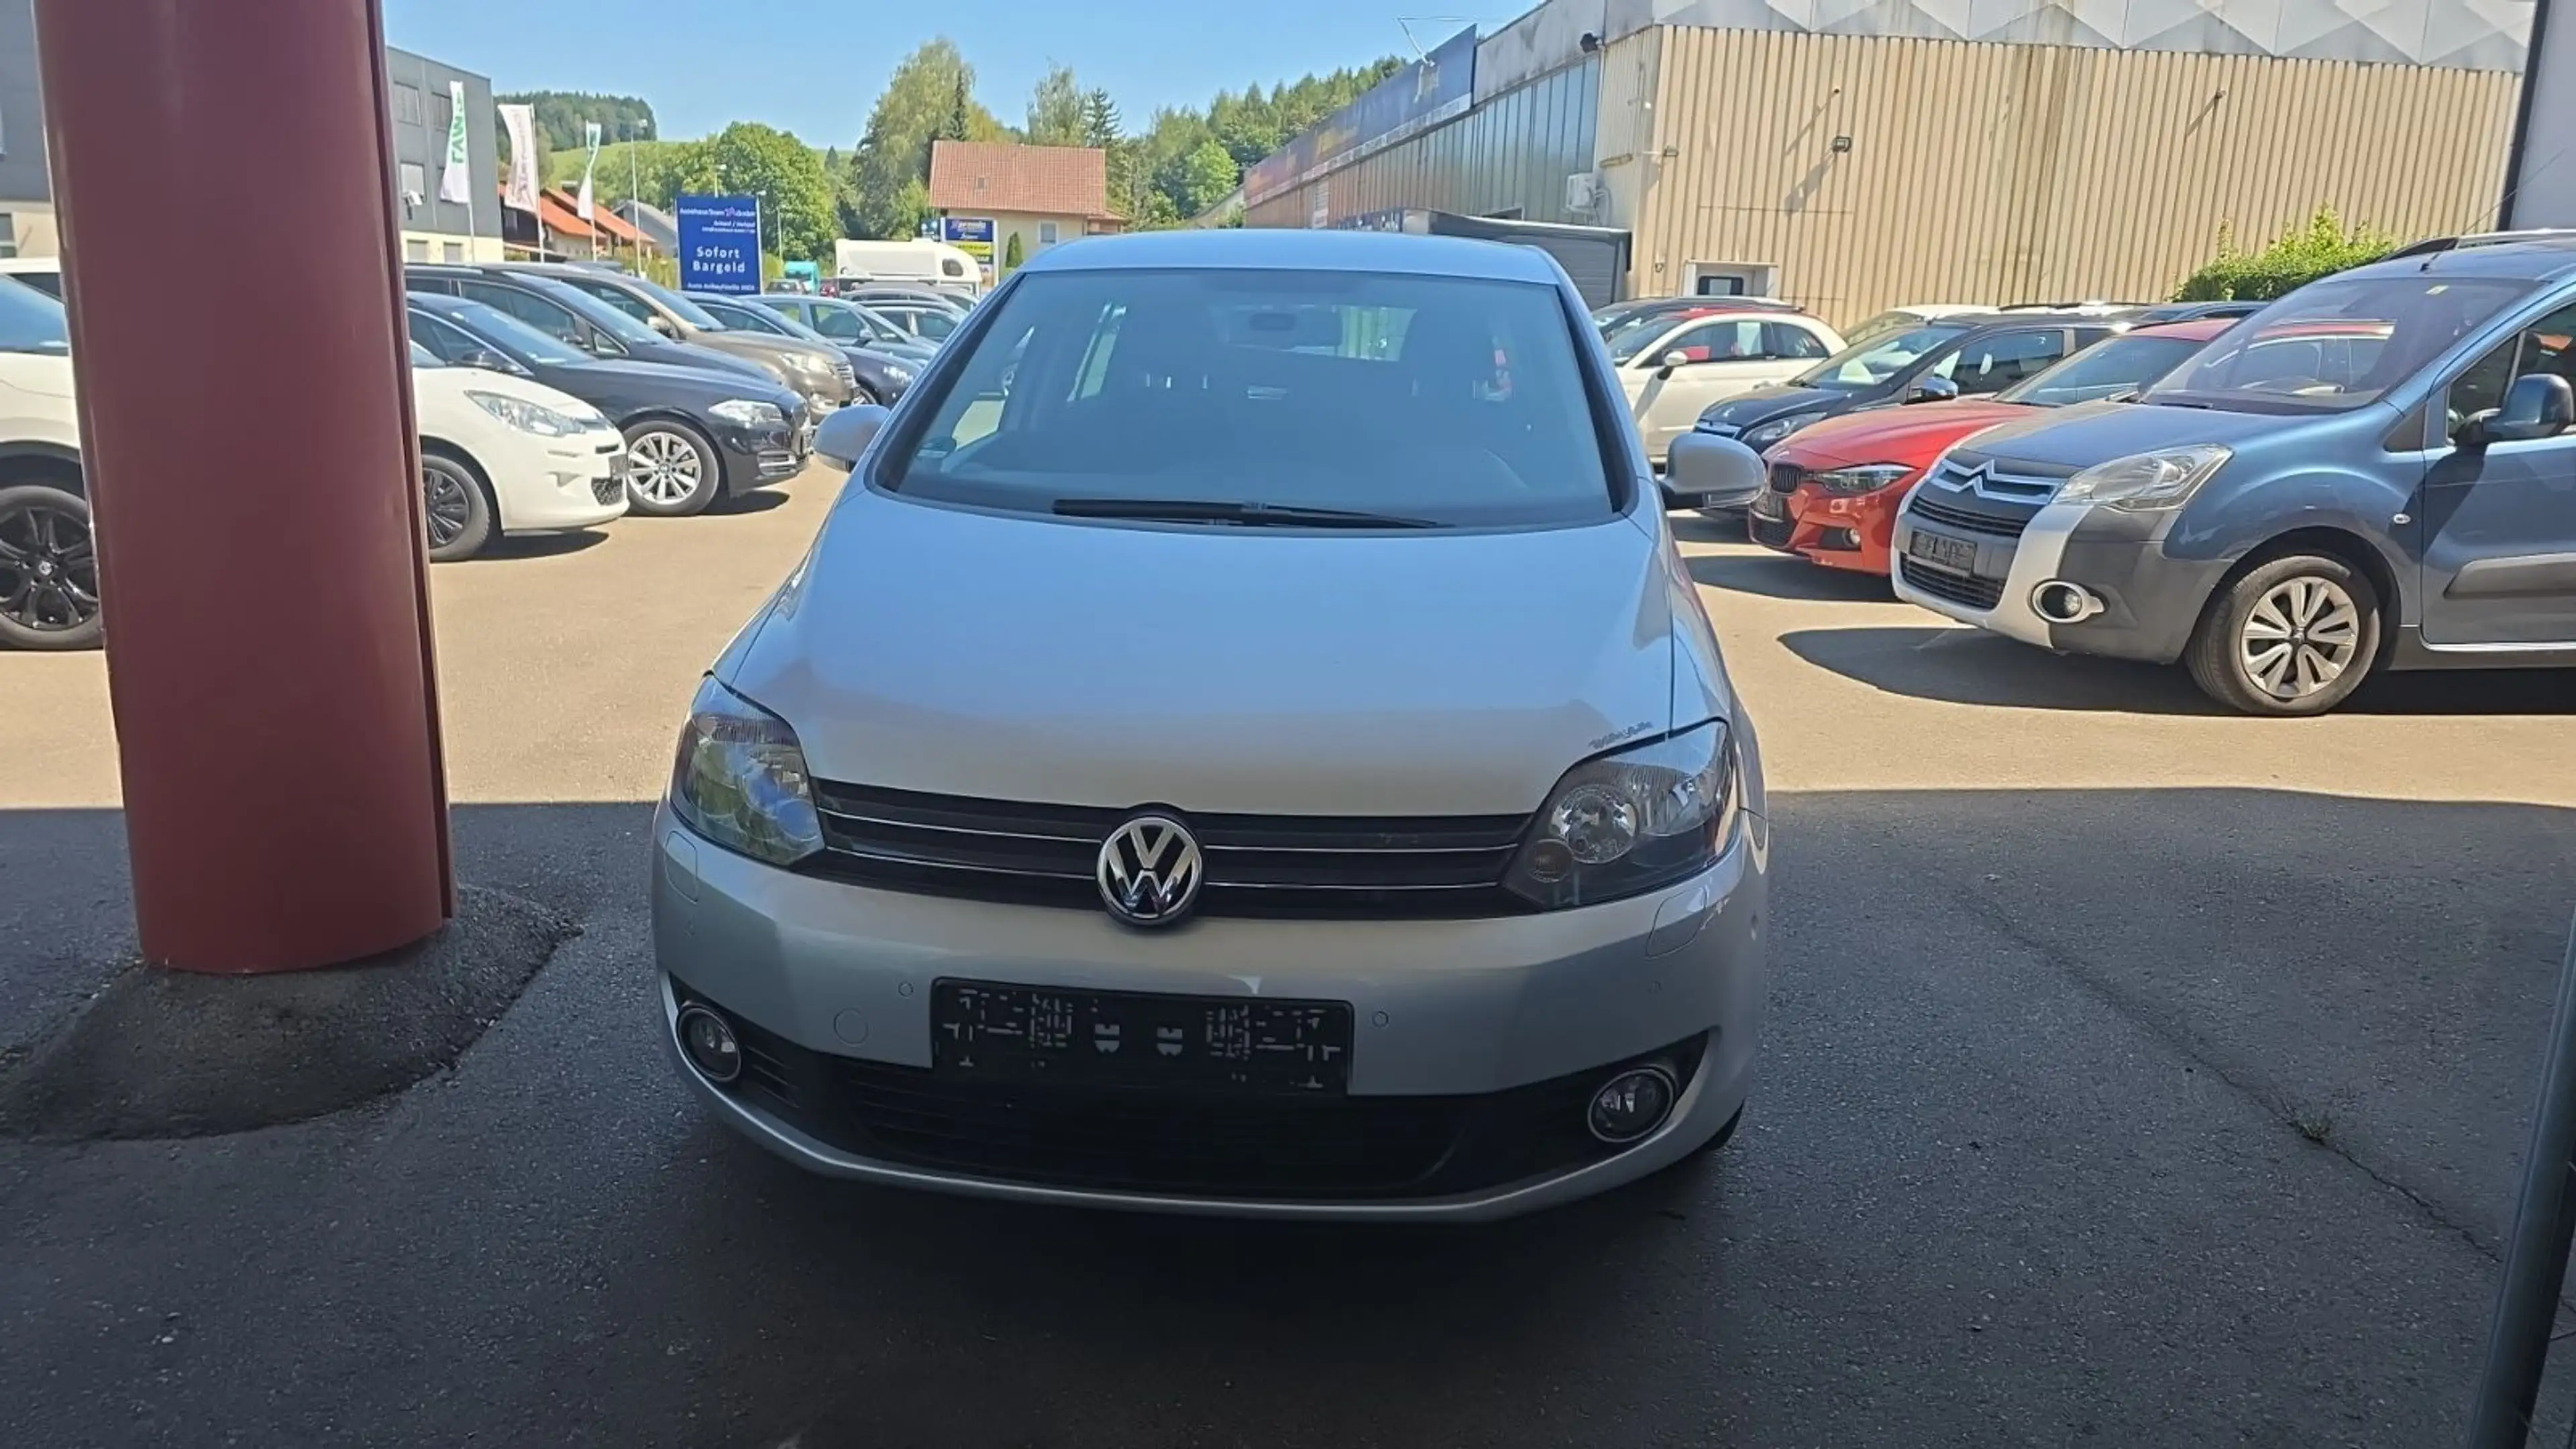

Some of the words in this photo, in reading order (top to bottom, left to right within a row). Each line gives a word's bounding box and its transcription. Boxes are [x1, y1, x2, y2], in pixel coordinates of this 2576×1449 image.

[696, 246, 740, 259] Sofort
[692, 260, 745, 274] Bargeld
[1099, 818, 1201, 919] VW
